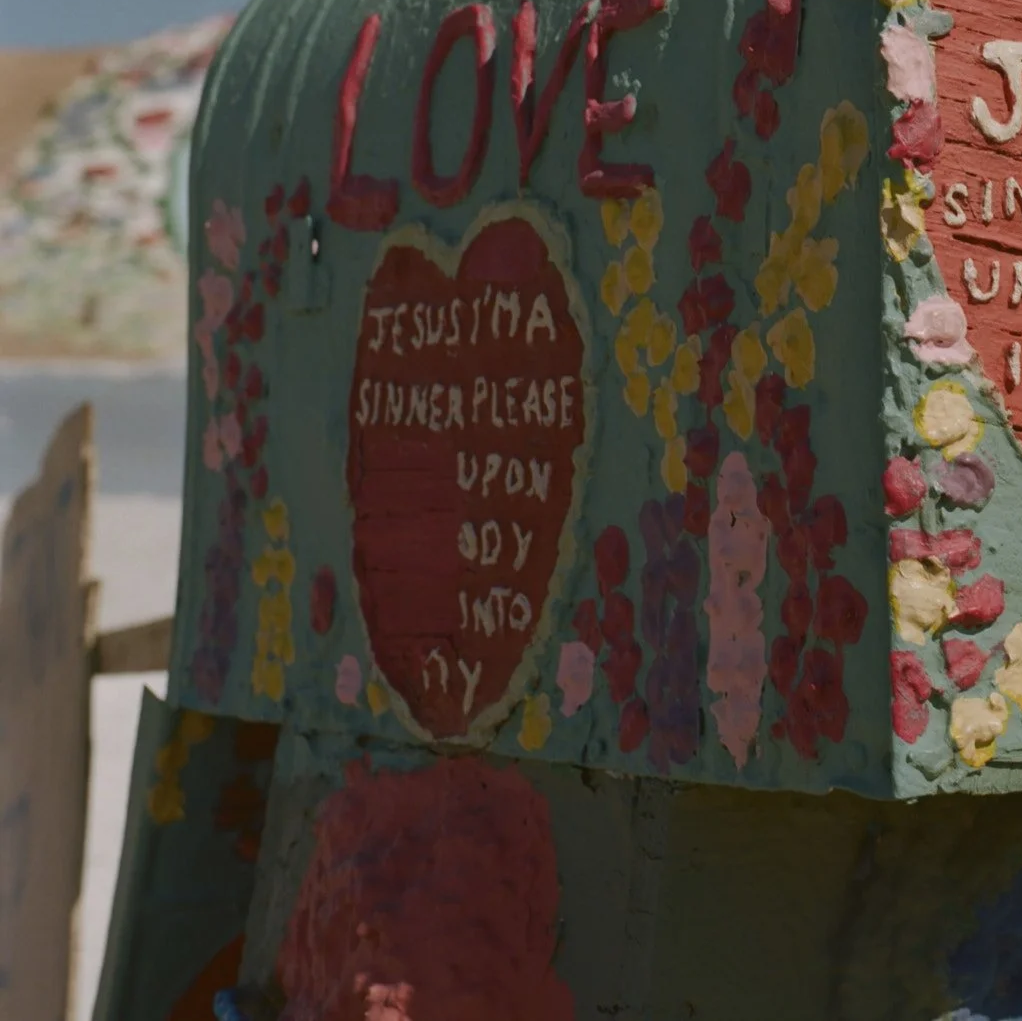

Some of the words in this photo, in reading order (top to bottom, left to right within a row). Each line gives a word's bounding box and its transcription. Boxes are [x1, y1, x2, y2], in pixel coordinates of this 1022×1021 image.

[368, 298, 462, 355] JESUS
[525, 293, 557, 344] A
[355, 378, 464, 431] SINNER
[471, 376, 576, 430] PLEASE
[456, 451, 552, 503] UPON
[458, 586, 532, 638] INTO
